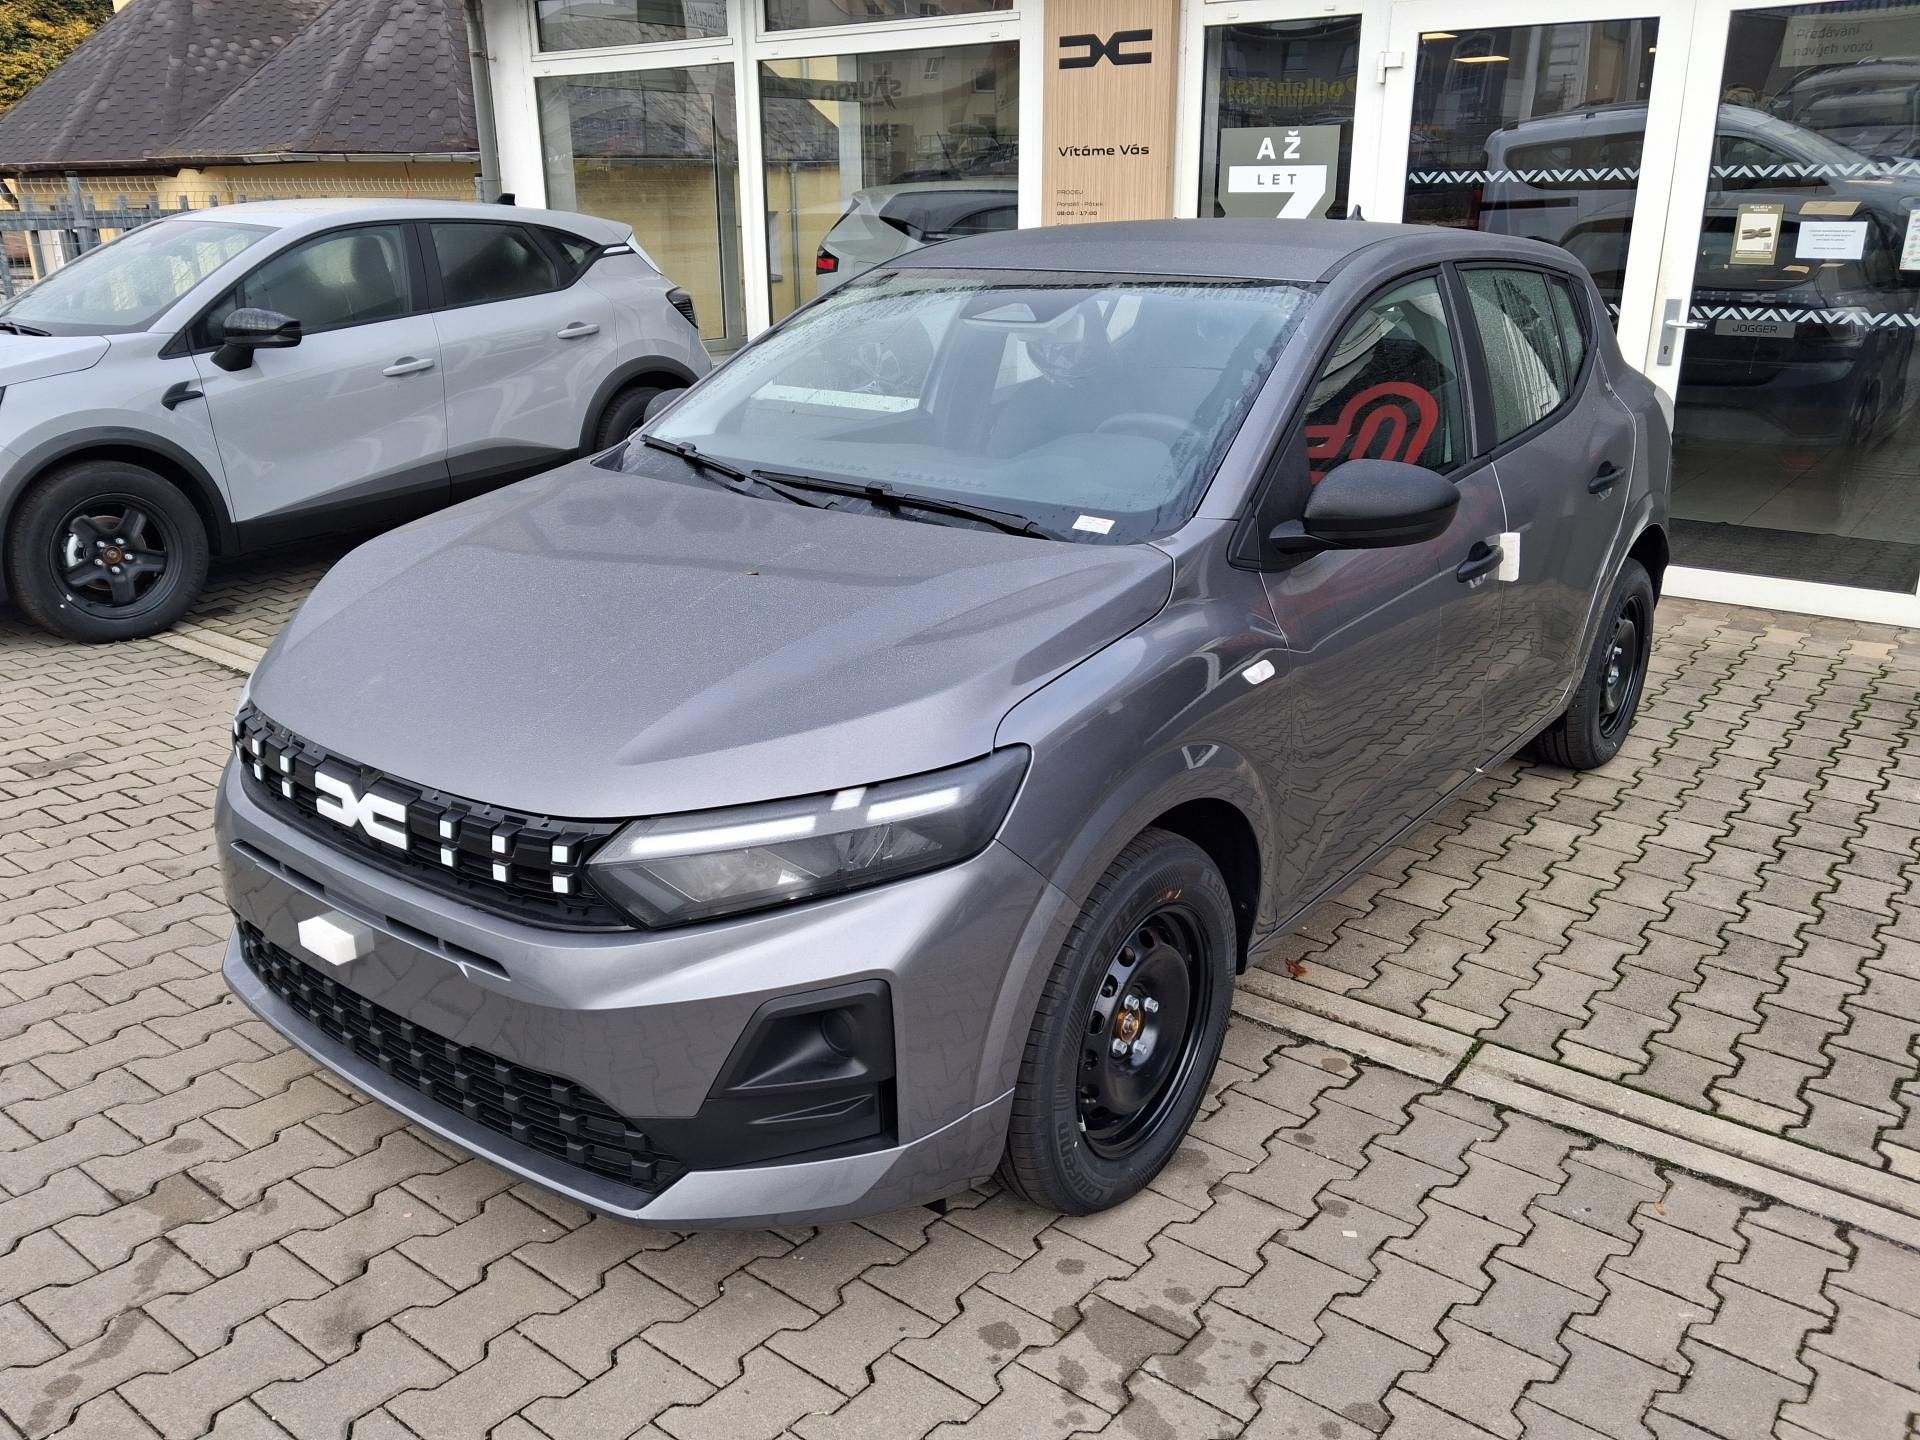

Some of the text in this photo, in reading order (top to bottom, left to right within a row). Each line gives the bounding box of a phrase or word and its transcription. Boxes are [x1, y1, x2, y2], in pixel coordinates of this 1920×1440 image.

[1058, 143, 1150, 157] Vítáme Vás
[1256, 130, 1301, 160] AŽ
[1257, 173, 1297, 185] LET
[1732, 324, 1778, 334] JOGGER
